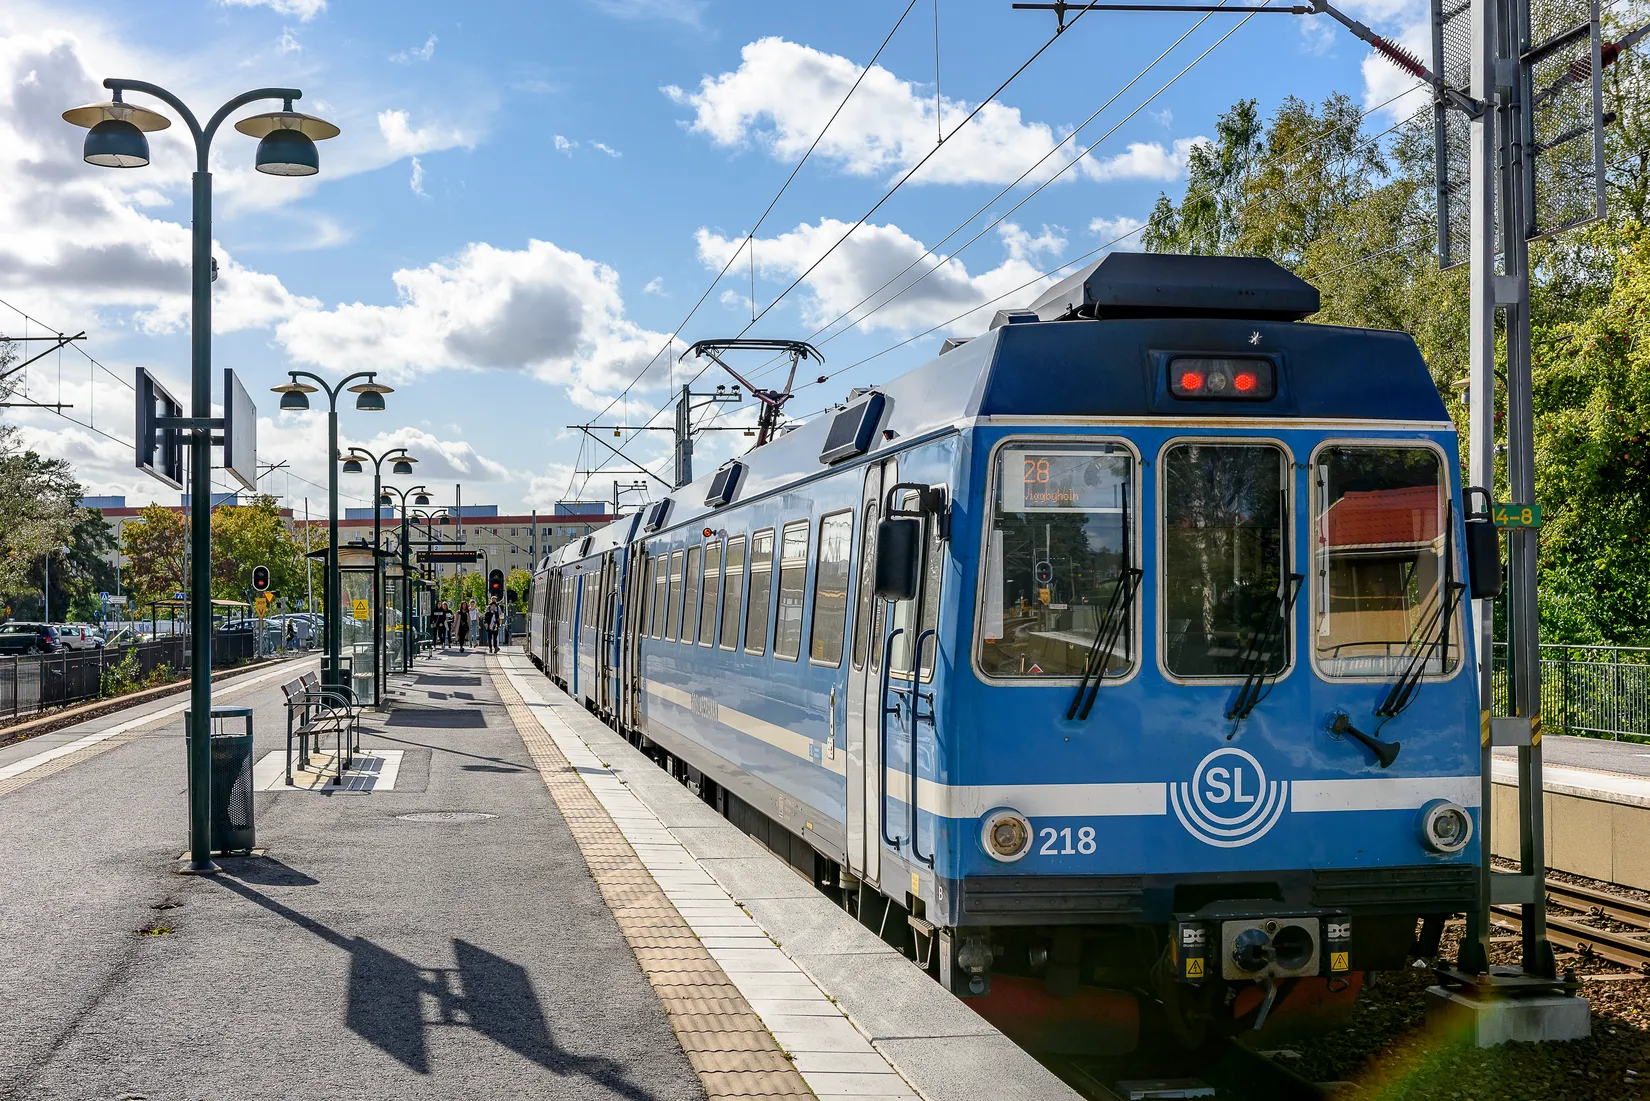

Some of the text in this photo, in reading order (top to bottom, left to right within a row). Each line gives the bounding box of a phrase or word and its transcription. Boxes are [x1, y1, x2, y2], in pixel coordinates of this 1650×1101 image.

[1023, 460, 1050, 483] 28
[1205, 767, 1254, 804] SL
[1039, 826, 1097, 855] 218
[938, 886, 943, 901] B
